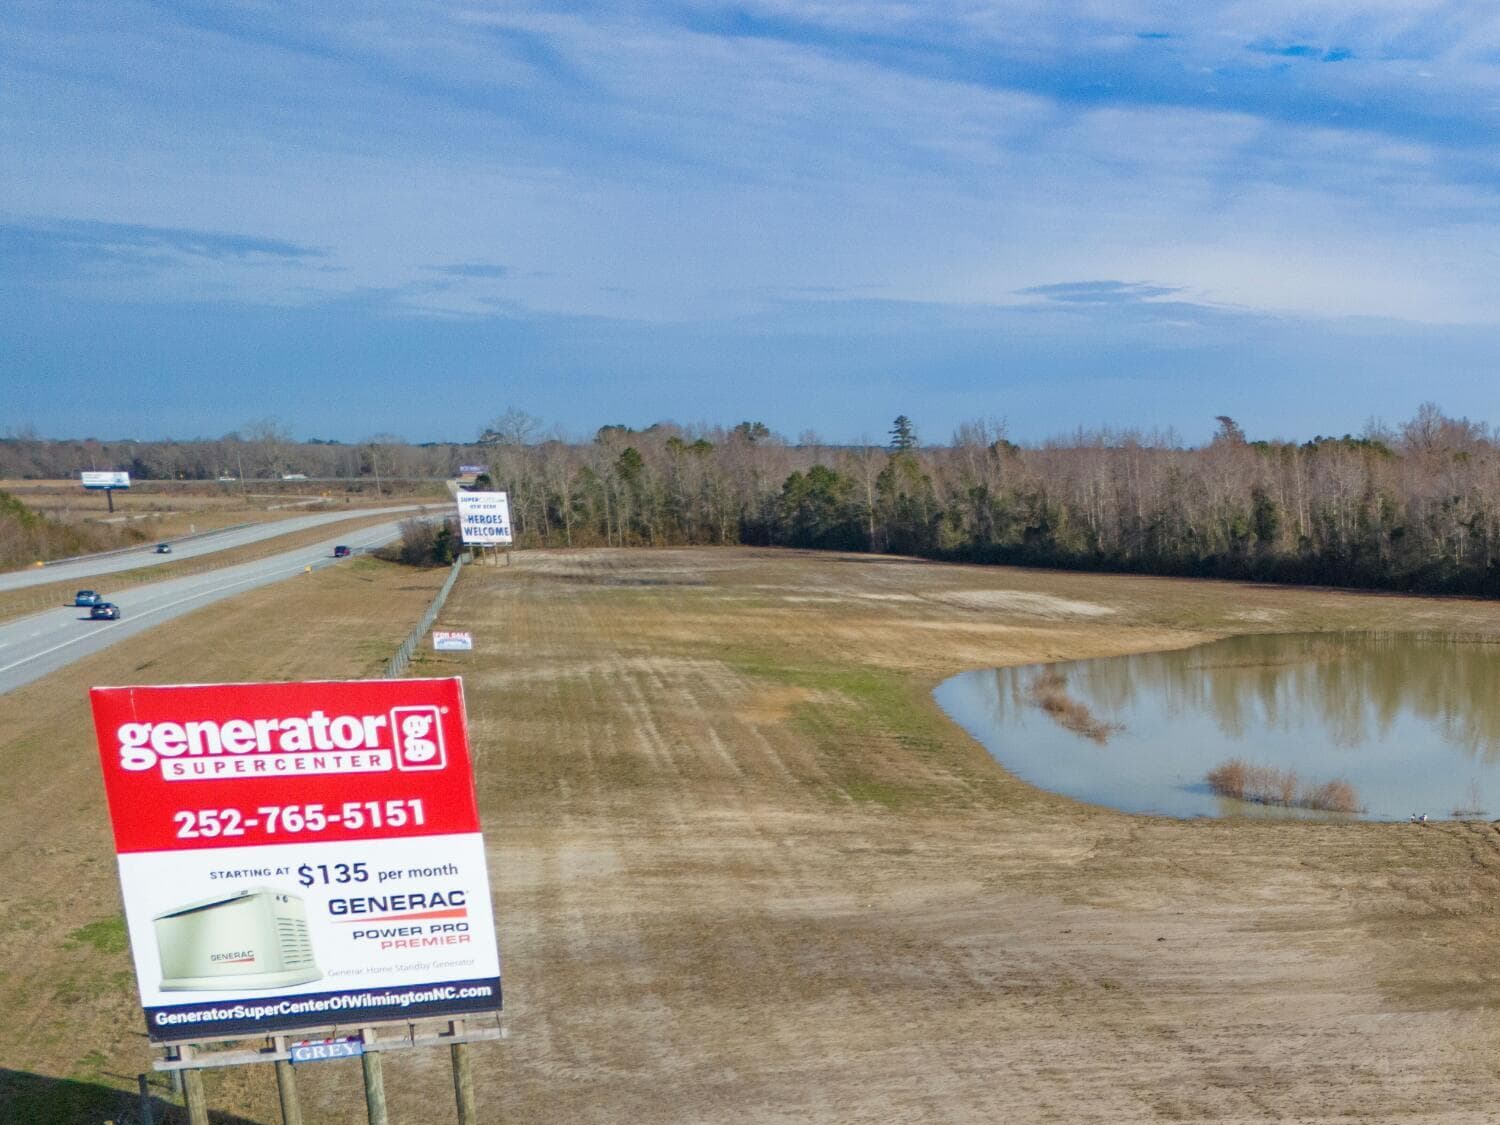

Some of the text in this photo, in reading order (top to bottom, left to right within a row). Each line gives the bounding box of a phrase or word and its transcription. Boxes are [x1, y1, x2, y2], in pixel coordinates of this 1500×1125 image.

[468, 514, 503, 524] HEROES
[464, 527, 510, 537] WELCOME
[117, 710, 386, 771] generator
[173, 754, 382, 776] SUPERCENTER
[174, 799, 425, 839] 252-765-5151
[209, 862, 459, 888] STARTING AT $135 per month
[328, 890, 466, 916] GENERAC
[353, 922, 470, 940] POWER PRO
[381, 934, 471, 950] PREMIER
[210, 950, 254, 962] GENERAC
[366, 964, 393, 974] Home
[394, 961, 431, 973] Standby
[432, 957, 475, 968] Generator
[155, 985, 493, 1026] GeneratorSuperCenterOfWilmingtonNC.com
[296, 1043, 357, 1060] GREY
